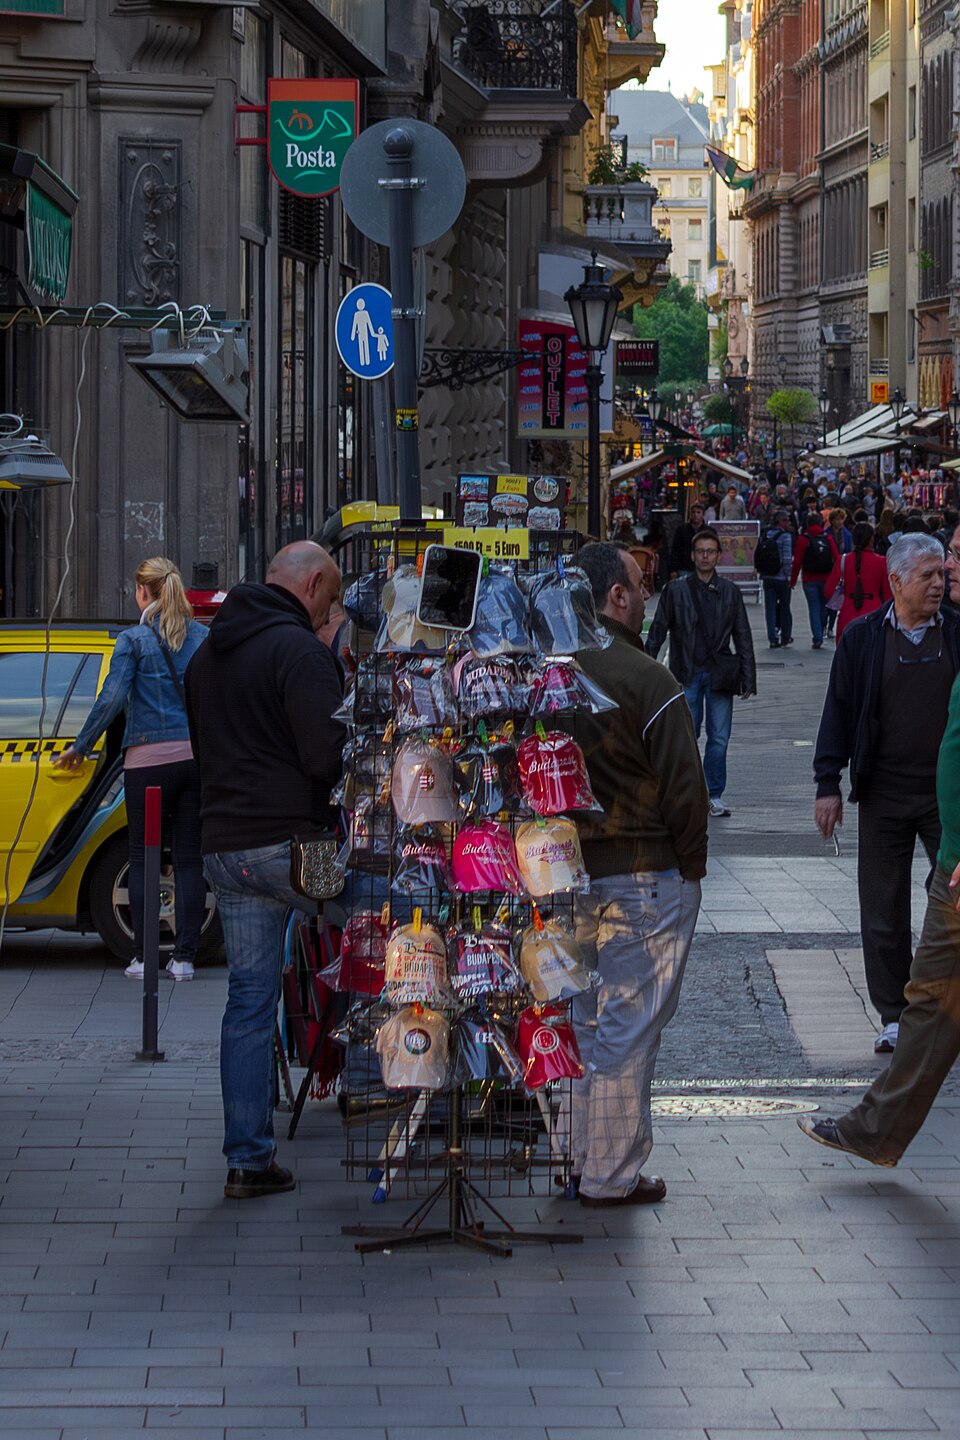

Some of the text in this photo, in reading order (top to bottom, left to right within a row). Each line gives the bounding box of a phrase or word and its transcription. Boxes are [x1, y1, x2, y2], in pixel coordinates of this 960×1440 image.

[285, 143, 337, 168] Posta
[618, 342, 654, 350] COSMO CITY
[547, 337, 562, 426] OUTLET
[494, 541, 501, 556] 5
[502, 541, 520, 556] Euro
